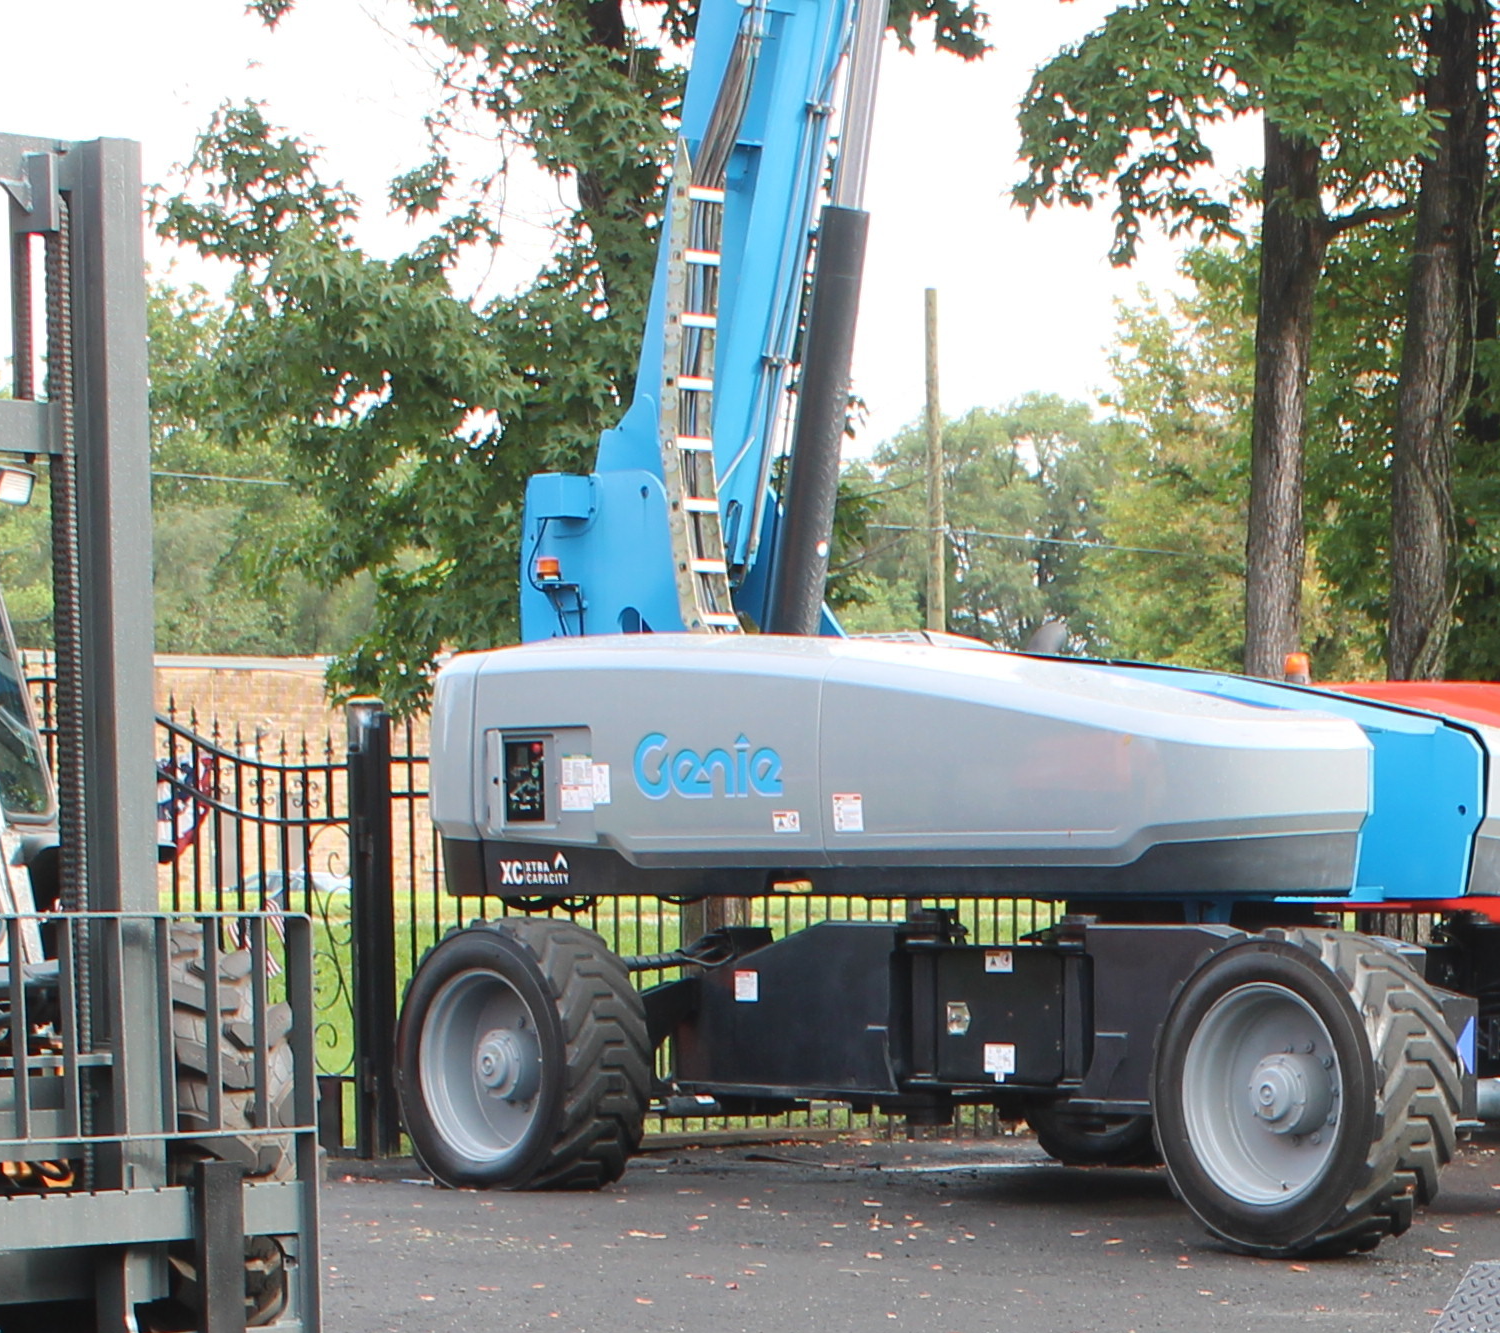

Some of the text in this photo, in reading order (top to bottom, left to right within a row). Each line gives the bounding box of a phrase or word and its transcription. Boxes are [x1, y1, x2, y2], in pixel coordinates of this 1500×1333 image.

[633, 732, 783, 800] Genie
[500, 861, 523, 884] XC
[525, 861, 550, 872] XTRA
[525, 873, 569, 884] CAPACITY
